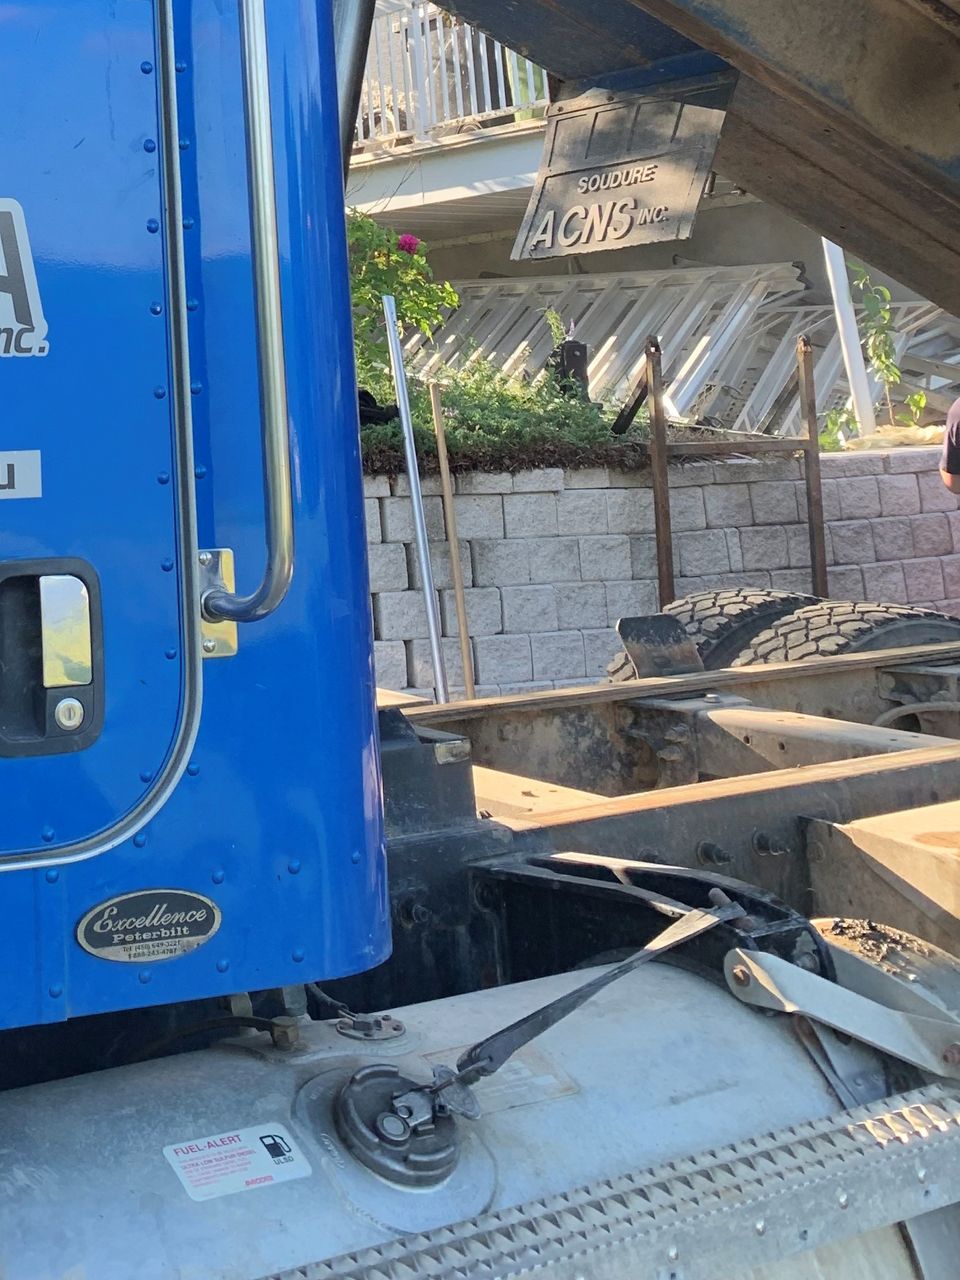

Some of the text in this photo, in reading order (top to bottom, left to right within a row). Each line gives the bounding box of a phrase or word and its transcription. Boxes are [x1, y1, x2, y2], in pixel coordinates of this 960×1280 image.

[577, 164, 658, 194] SOUDURE
[531, 197, 669, 250] ACNS INC.
[93, 903, 207, 932] Excellence
[112, 926, 190, 944] Peterbilt
[174, 1135, 242, 1156] FUEL-ALERT
